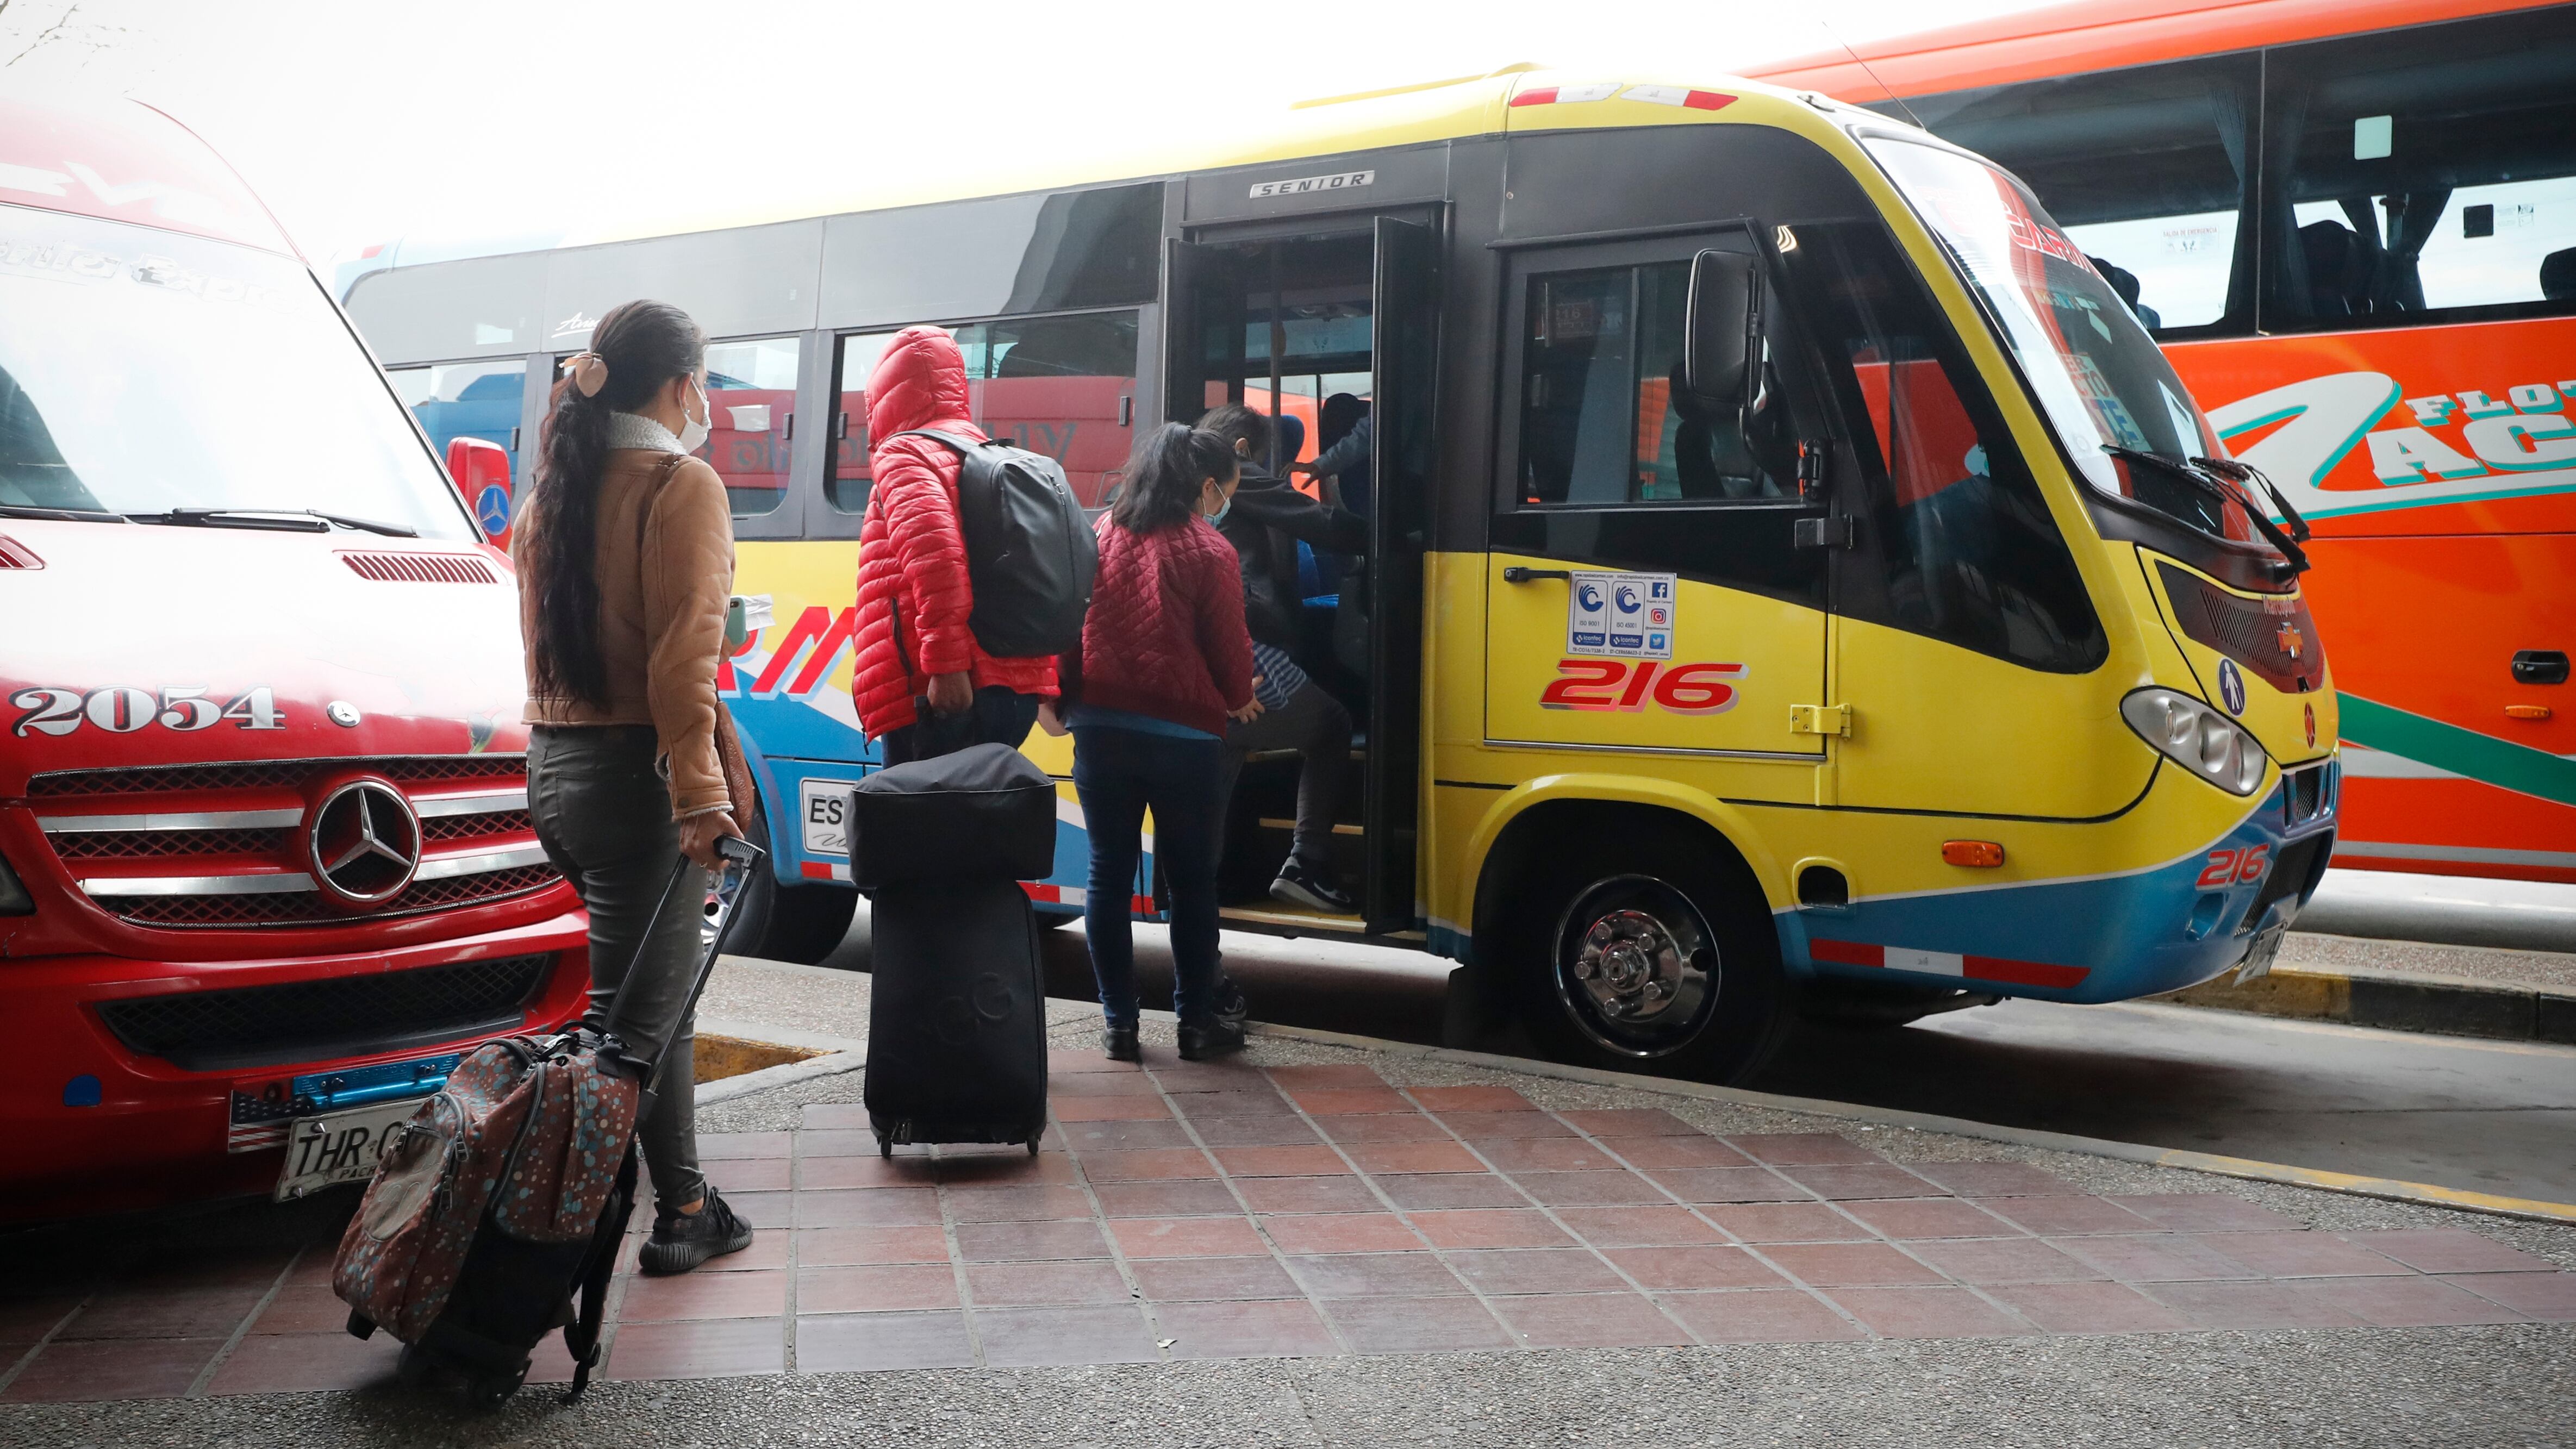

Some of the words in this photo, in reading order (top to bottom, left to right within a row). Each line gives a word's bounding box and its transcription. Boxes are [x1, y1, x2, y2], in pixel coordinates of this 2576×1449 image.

[1260, 173, 1365, 197] SENIOR
[7, 683, 286, 738] 2054
[1539, 658, 1750, 716] 216
[2195, 843, 2269, 892] 216
[338, 1166, 381, 1180] PACH
